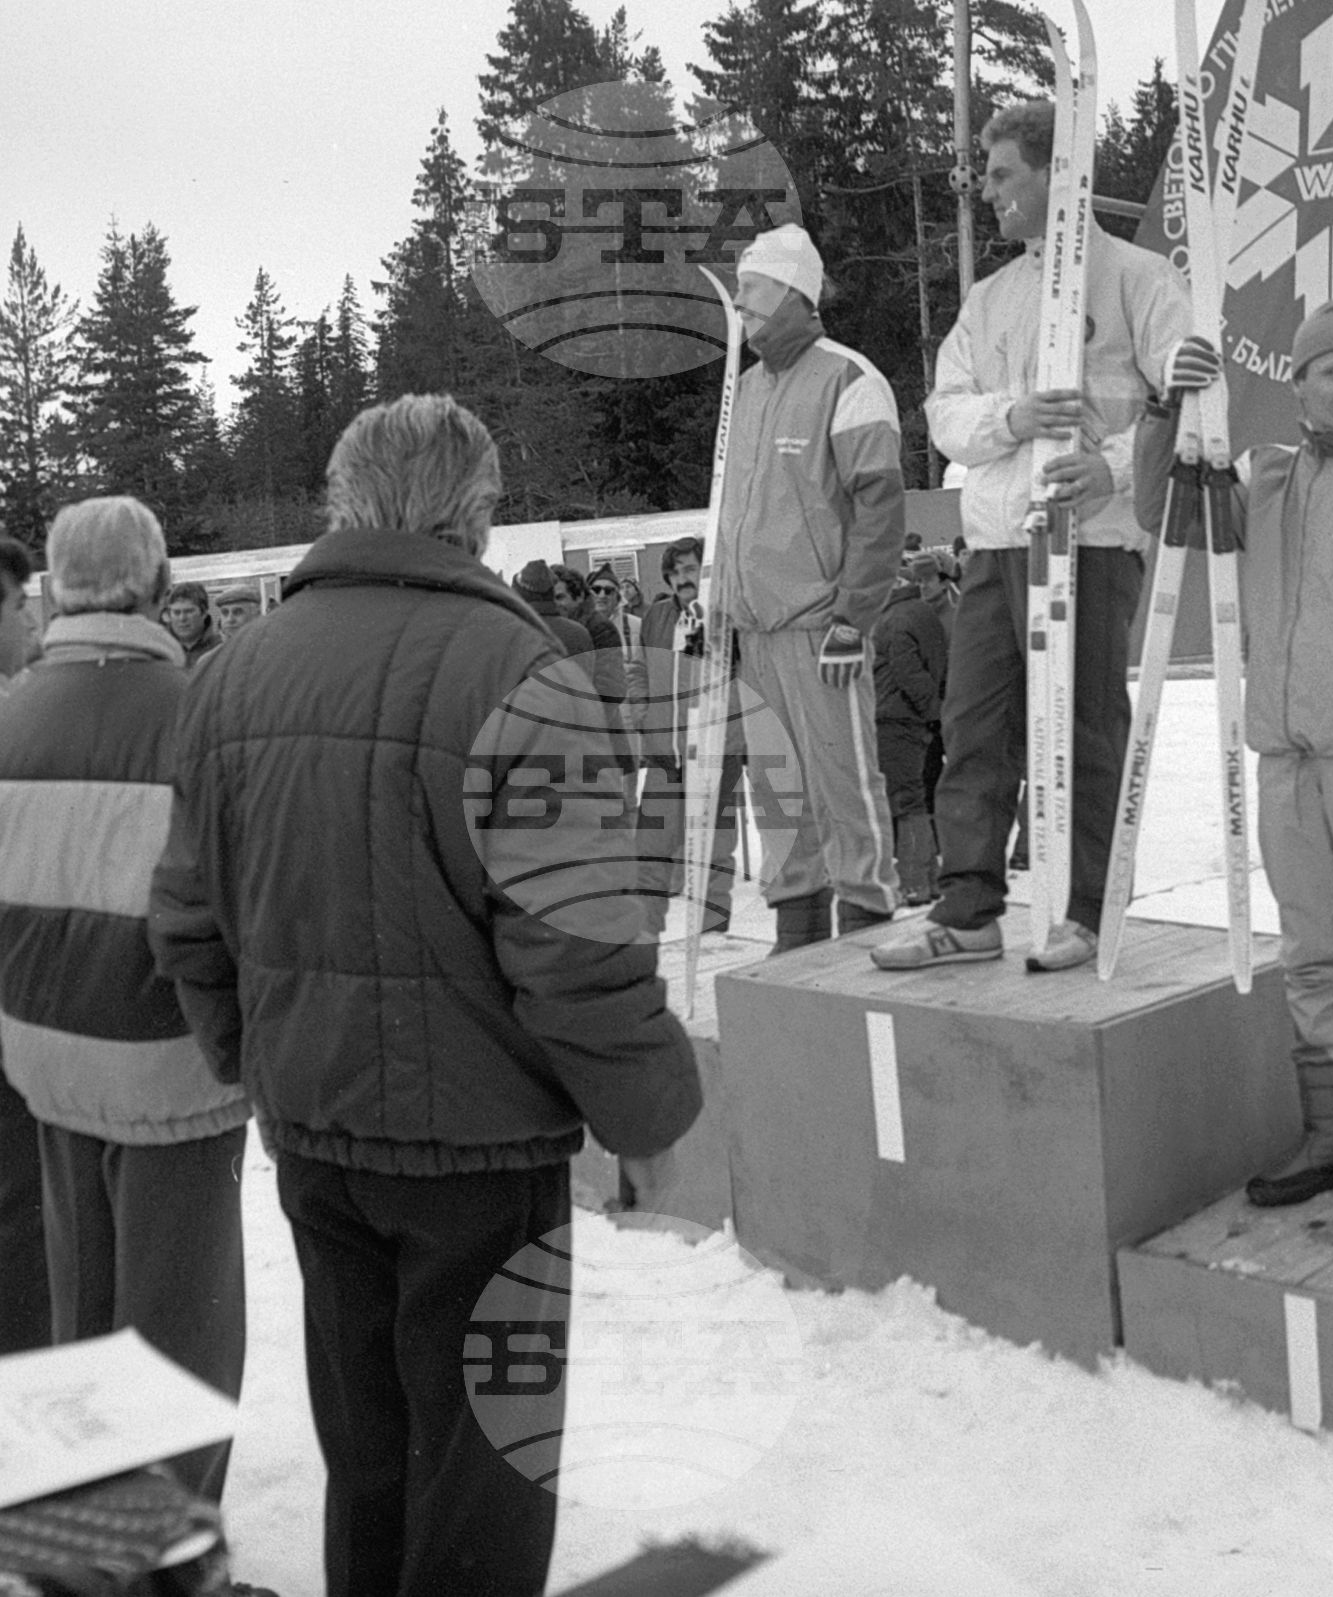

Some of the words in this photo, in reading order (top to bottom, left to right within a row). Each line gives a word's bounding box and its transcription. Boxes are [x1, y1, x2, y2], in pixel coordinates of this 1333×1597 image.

[1183, 90, 1206, 194] KARHU
[1221, 90, 1248, 195] KARHU
[1124, 740, 1150, 826] MATRIX
[1226, 749, 1244, 836] MATRIX
